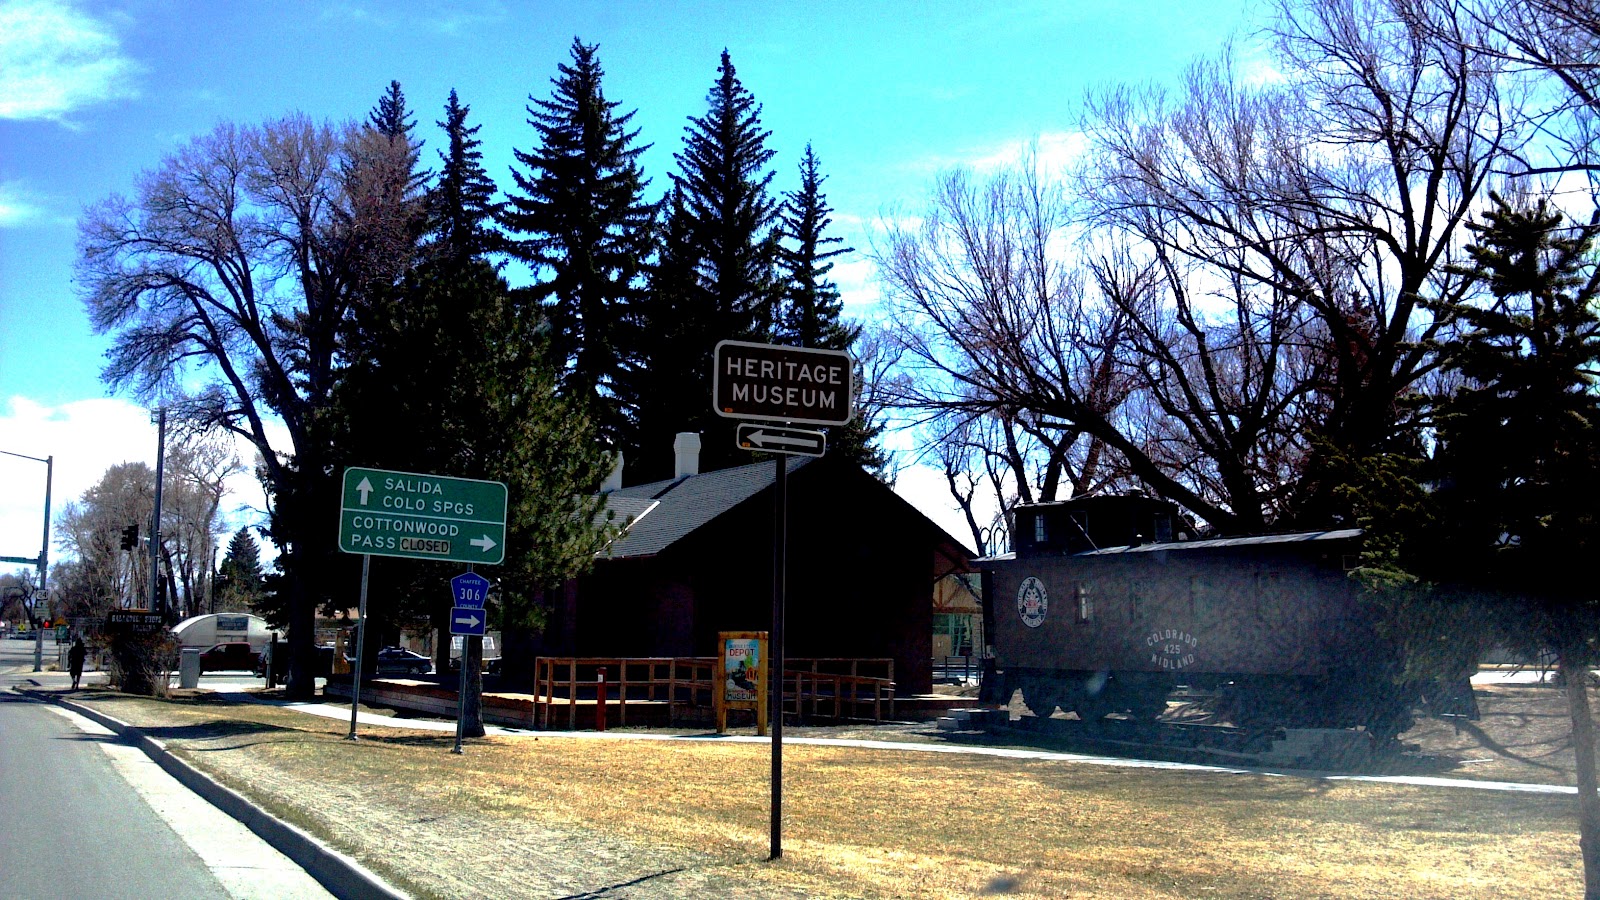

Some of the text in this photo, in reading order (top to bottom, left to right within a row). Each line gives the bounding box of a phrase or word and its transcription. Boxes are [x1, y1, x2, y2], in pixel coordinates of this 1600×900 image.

[727, 357, 842, 385] HERITAGE
[732, 383, 835, 409] MUSEUM
[385, 478, 443, 495] SALIDA
[383, 496, 474, 515] COLO SPGS
[352, 516, 459, 537] COTTONWOOD
[351, 534, 449, 552] PASS CLOSED
[460, 588, 480, 601] 306
[1146, 629, 1198, 648] COLORADO
[729, 648, 755, 656] DEPOT
[1164, 644, 1181, 655] 425
[1151, 653, 1195, 670] MIDLAND
